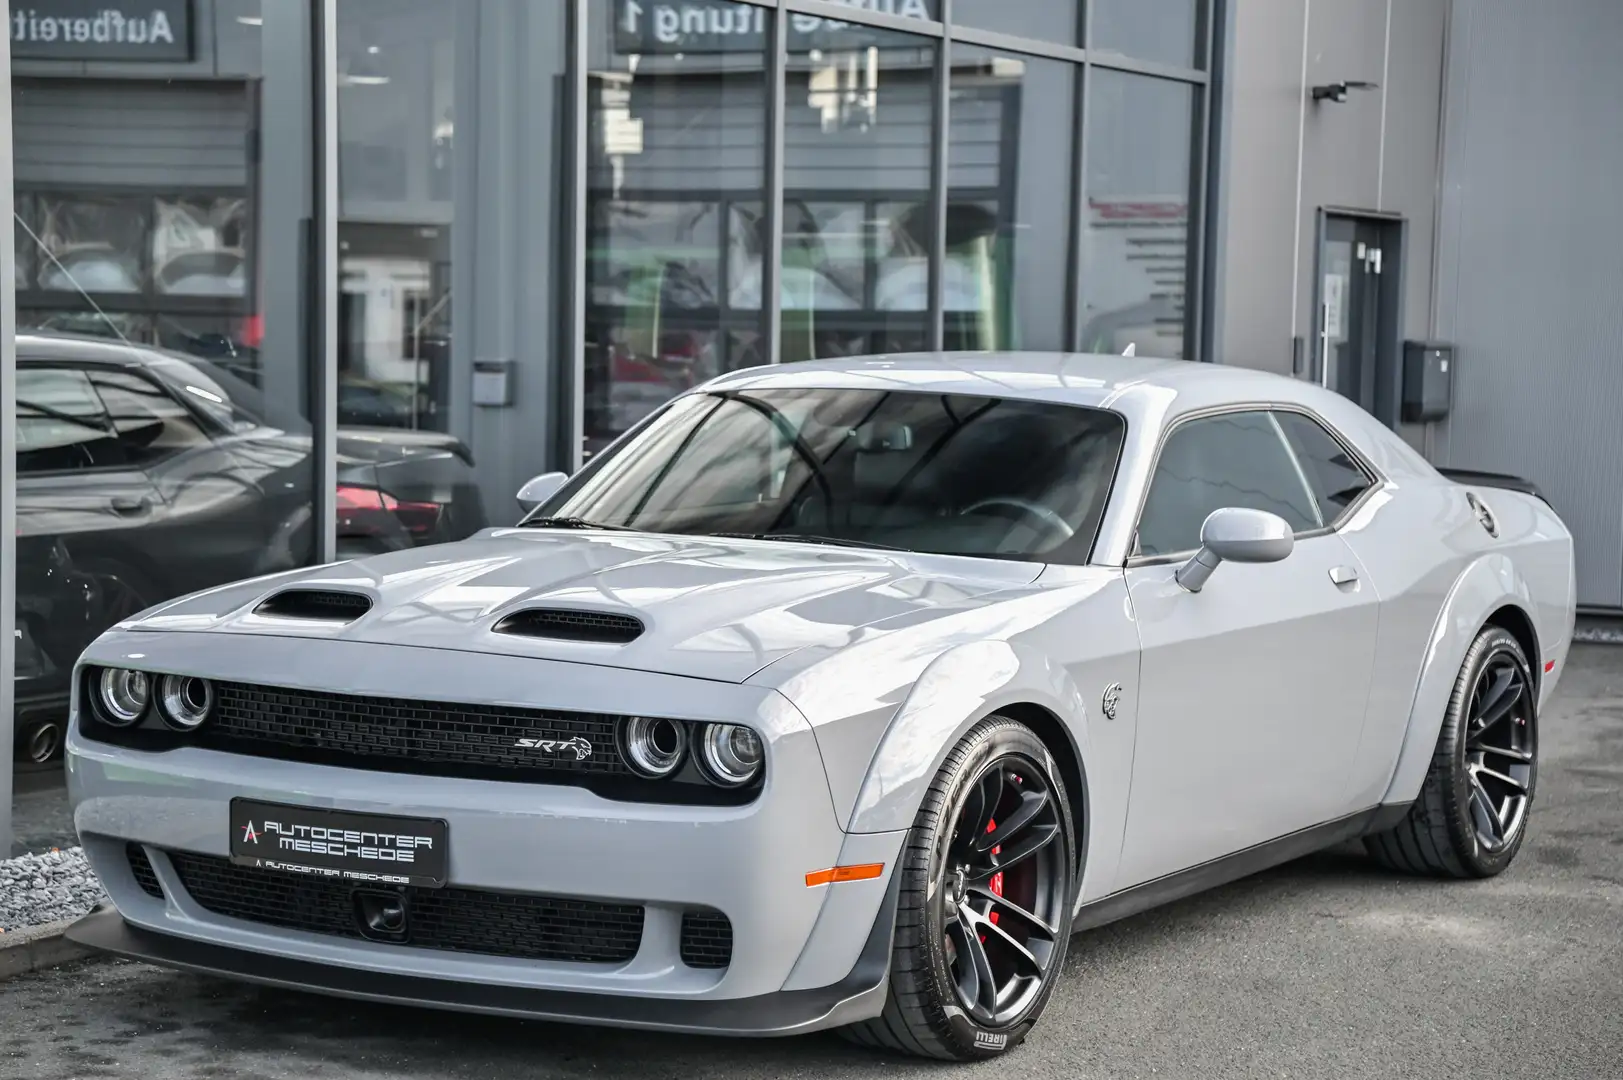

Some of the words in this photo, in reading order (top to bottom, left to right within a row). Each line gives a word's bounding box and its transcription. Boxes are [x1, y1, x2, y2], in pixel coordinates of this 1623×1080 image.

[514, 738, 577, 753] SRT
[264, 821, 433, 850] AUTOCENTER
[279, 837, 415, 862] MESCHEDE
[265, 860, 340, 877] AUTOCENTER
[343, 871, 410, 884] MESCHEDE
[973, 1031, 1008, 1051] PIRELLI
